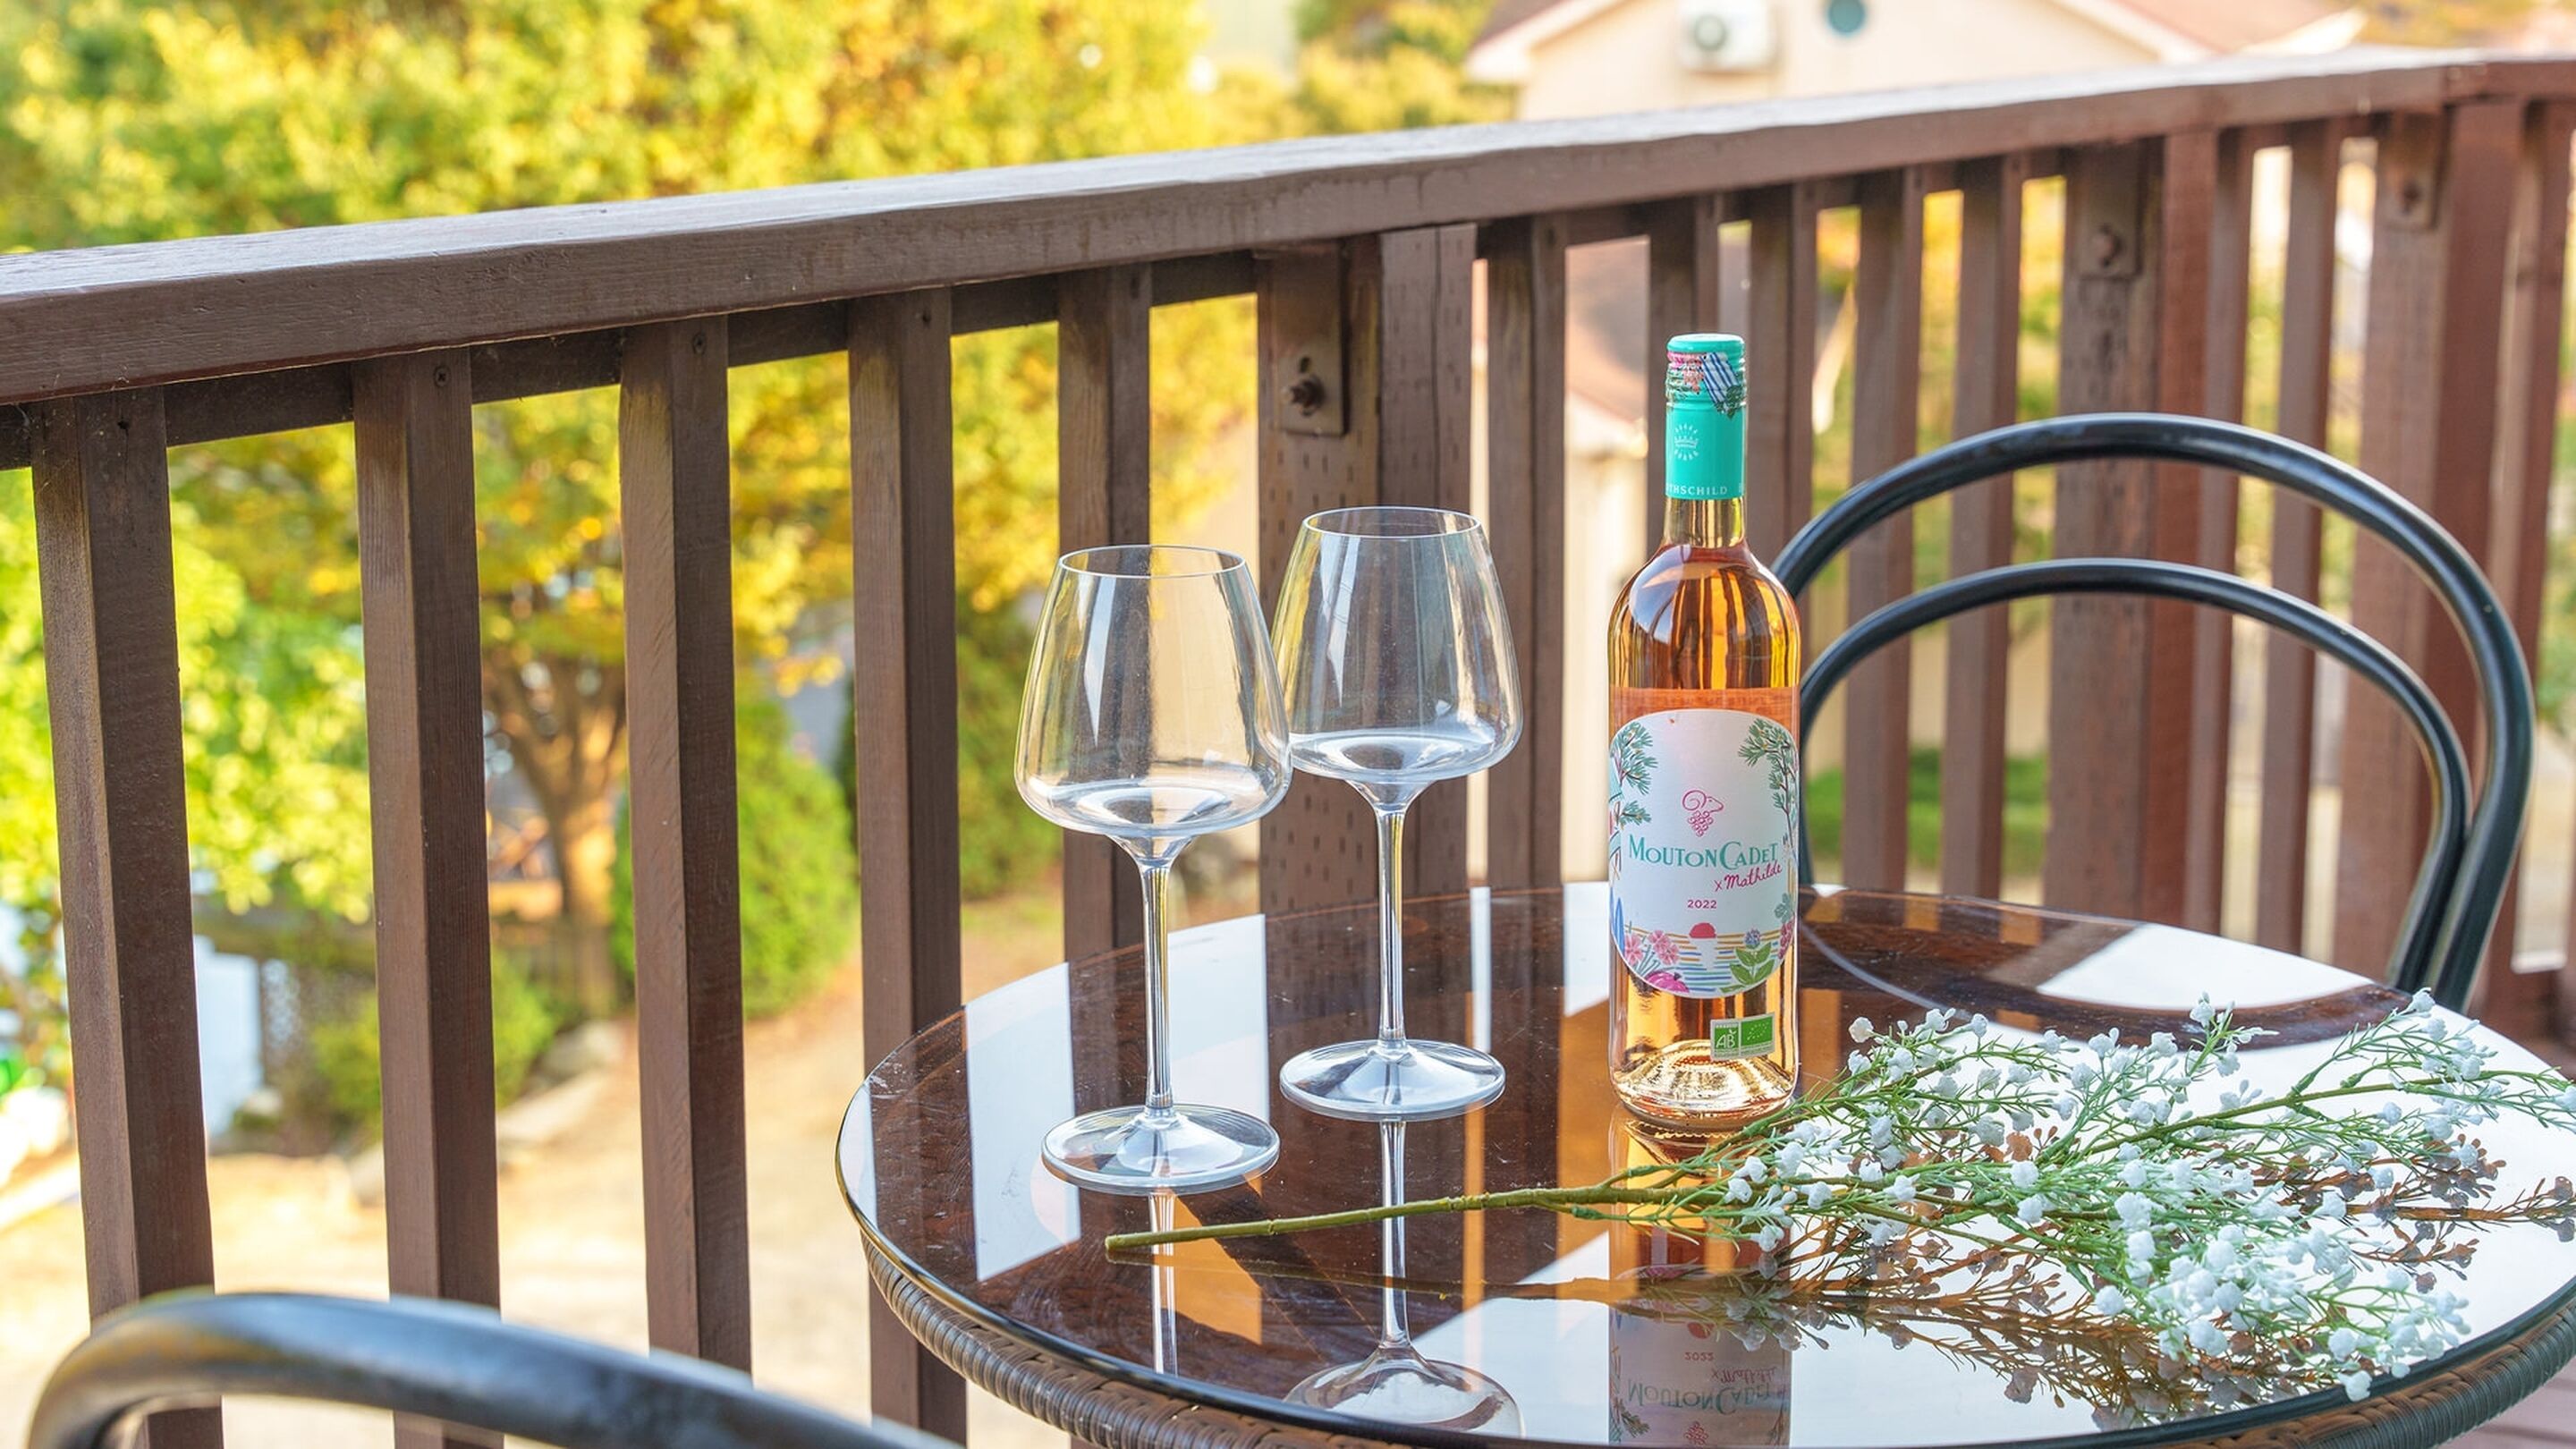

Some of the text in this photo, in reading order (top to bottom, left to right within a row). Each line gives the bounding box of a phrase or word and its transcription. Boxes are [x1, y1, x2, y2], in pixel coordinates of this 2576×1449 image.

[1724, 860, 1783, 890] Mathilde
[1687, 899, 1717, 909] 2022
[1716, 1033, 1736, 1049] AB
